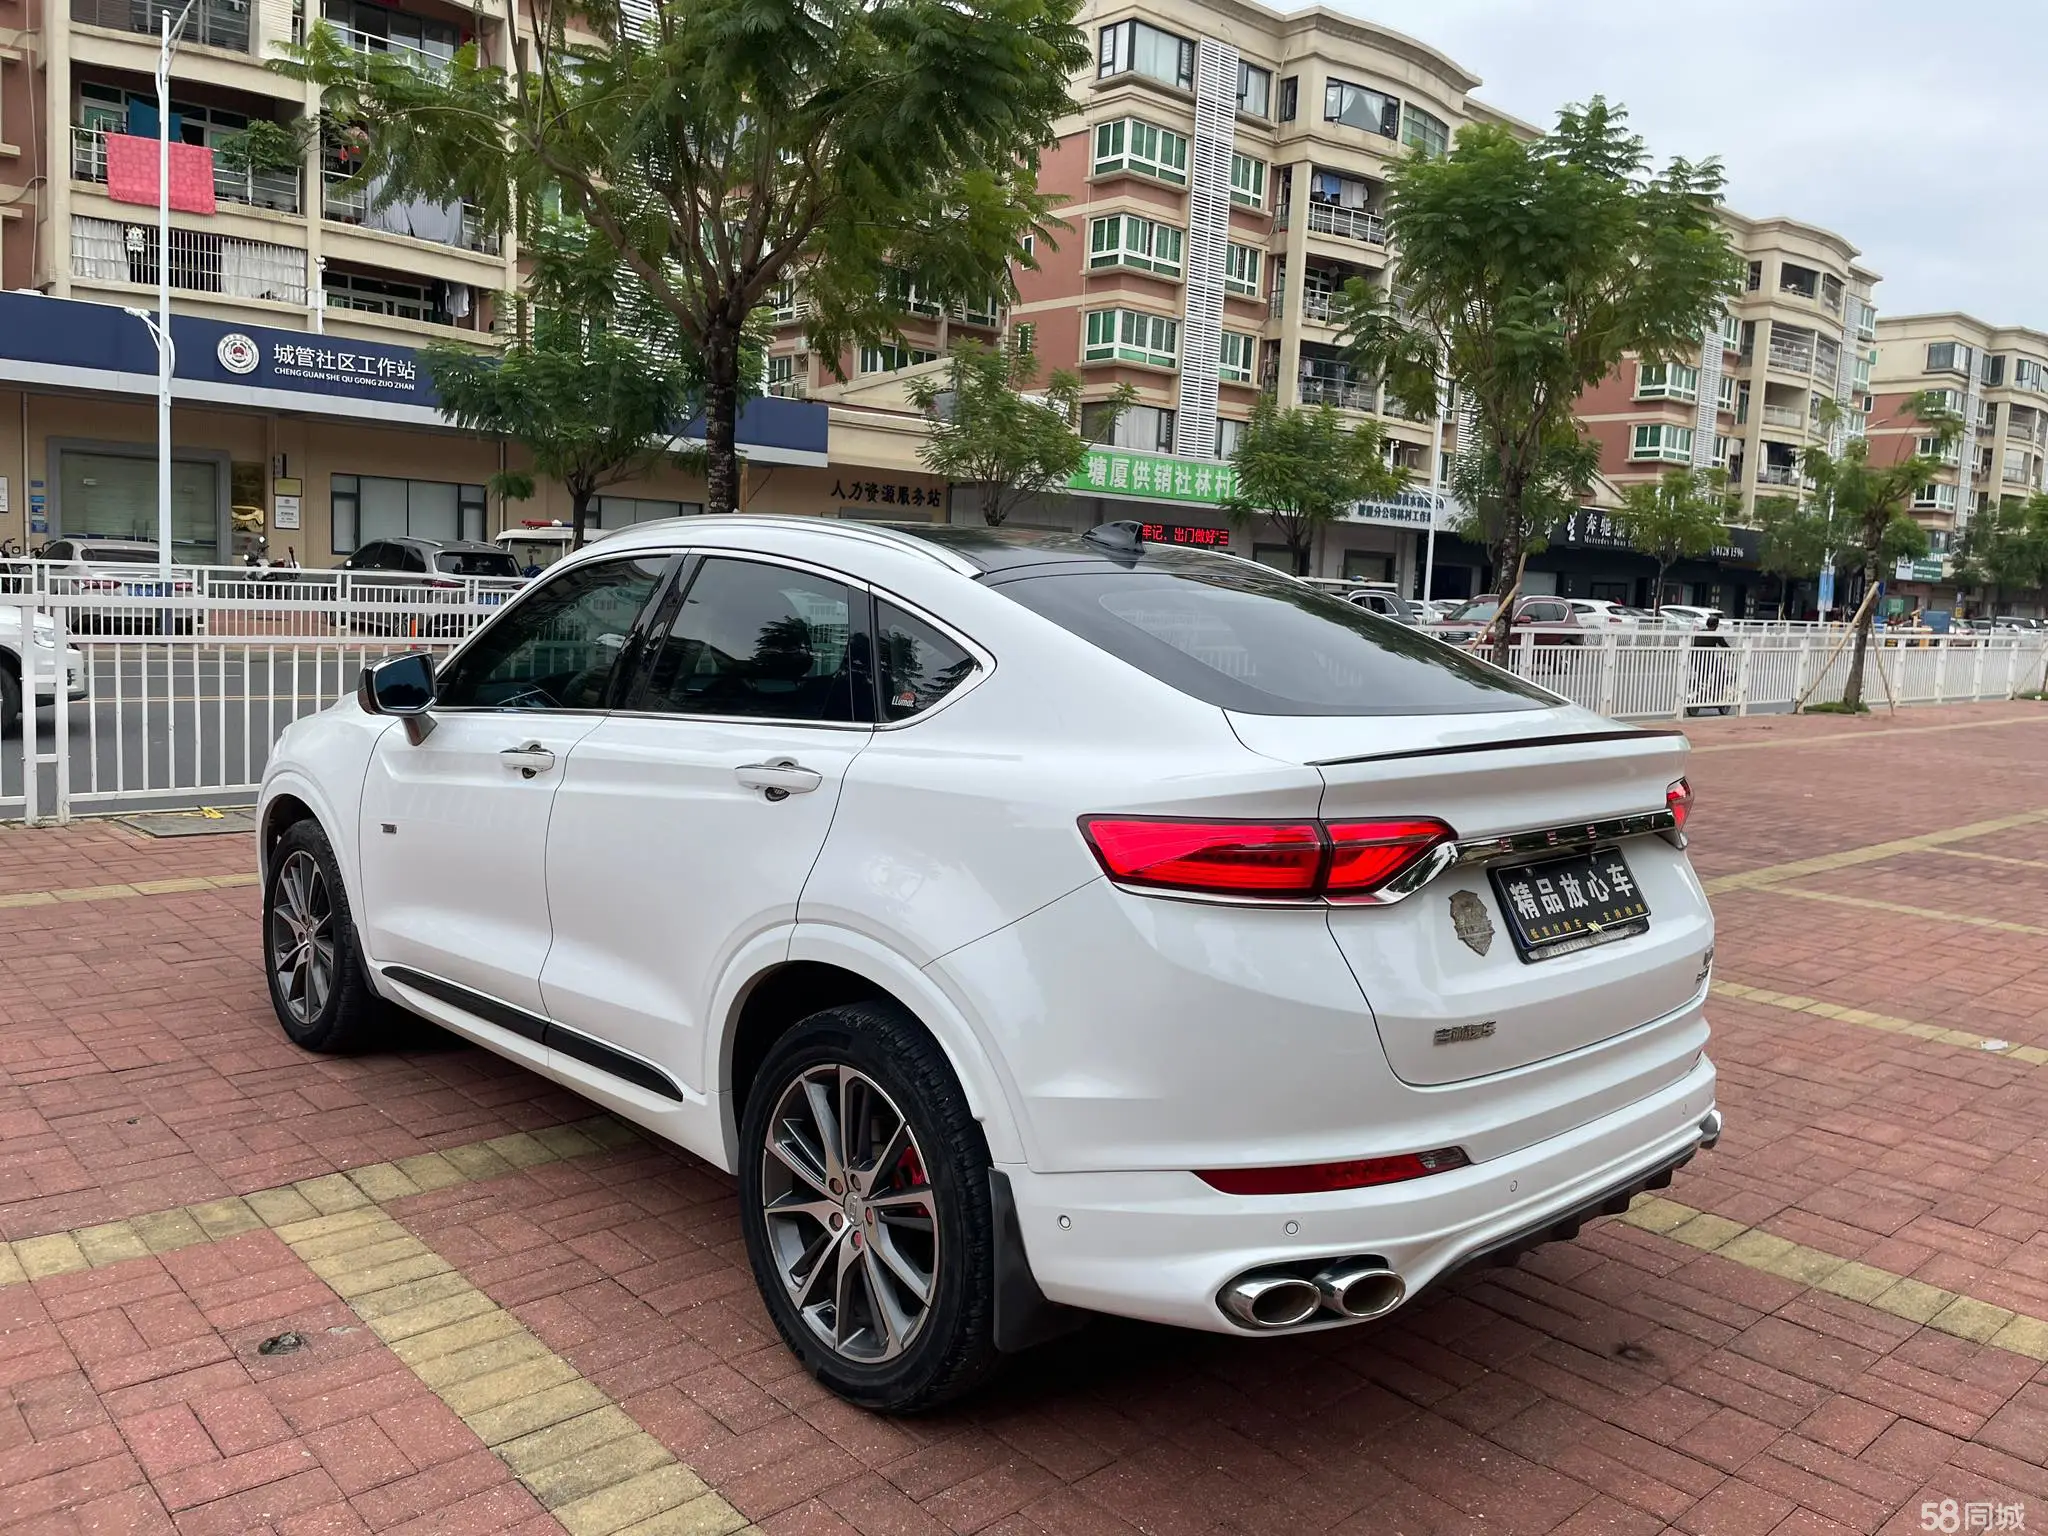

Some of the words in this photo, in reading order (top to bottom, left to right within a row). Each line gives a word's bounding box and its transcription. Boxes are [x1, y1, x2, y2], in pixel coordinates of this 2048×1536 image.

[273, 343, 416, 381] 城管社区工作站
[274, 367, 302, 377] CHENG
[302, 371, 325, 380] GUAN
[325, 373, 341, 382] SHE
[341, 376, 354, 385] QU
[354, 377, 378, 387] GONG
[377, 380, 394, 389] ZUO
[394, 382, 415, 391] ZHAN
[831, 479, 942, 507] 人力资源服务站
[1088, 456, 1243, 499] 塘厦供销社林村
[1509, 863, 1634, 920] 精品放心车
